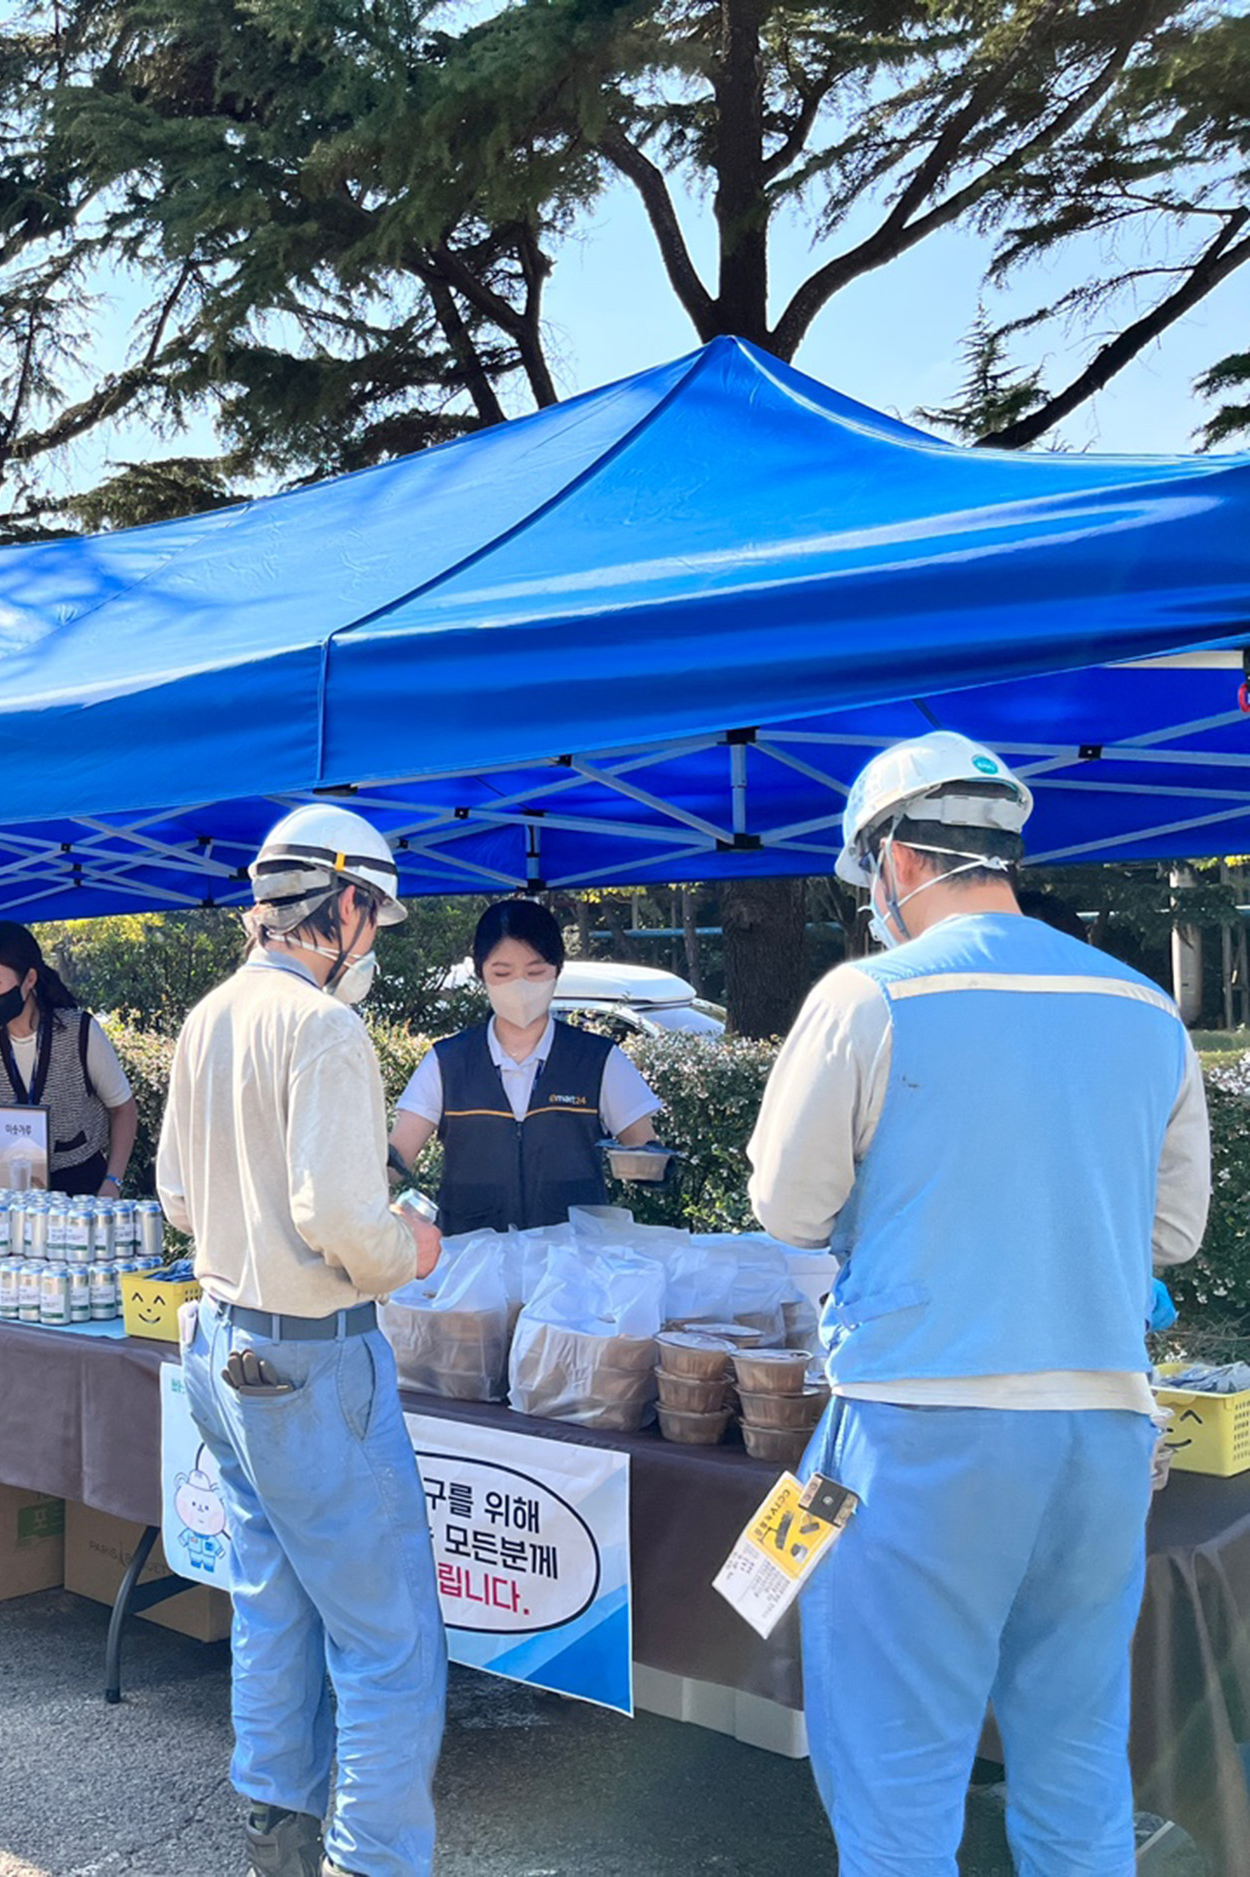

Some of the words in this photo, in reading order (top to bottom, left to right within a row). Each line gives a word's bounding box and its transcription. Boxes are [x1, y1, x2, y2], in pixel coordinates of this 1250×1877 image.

[423, 1476, 474, 1519] 구를
[484, 1491, 540, 1534] 위해
[444, 1523, 558, 1580] 모든분께
[438, 1561, 530, 1616] 립니다.
